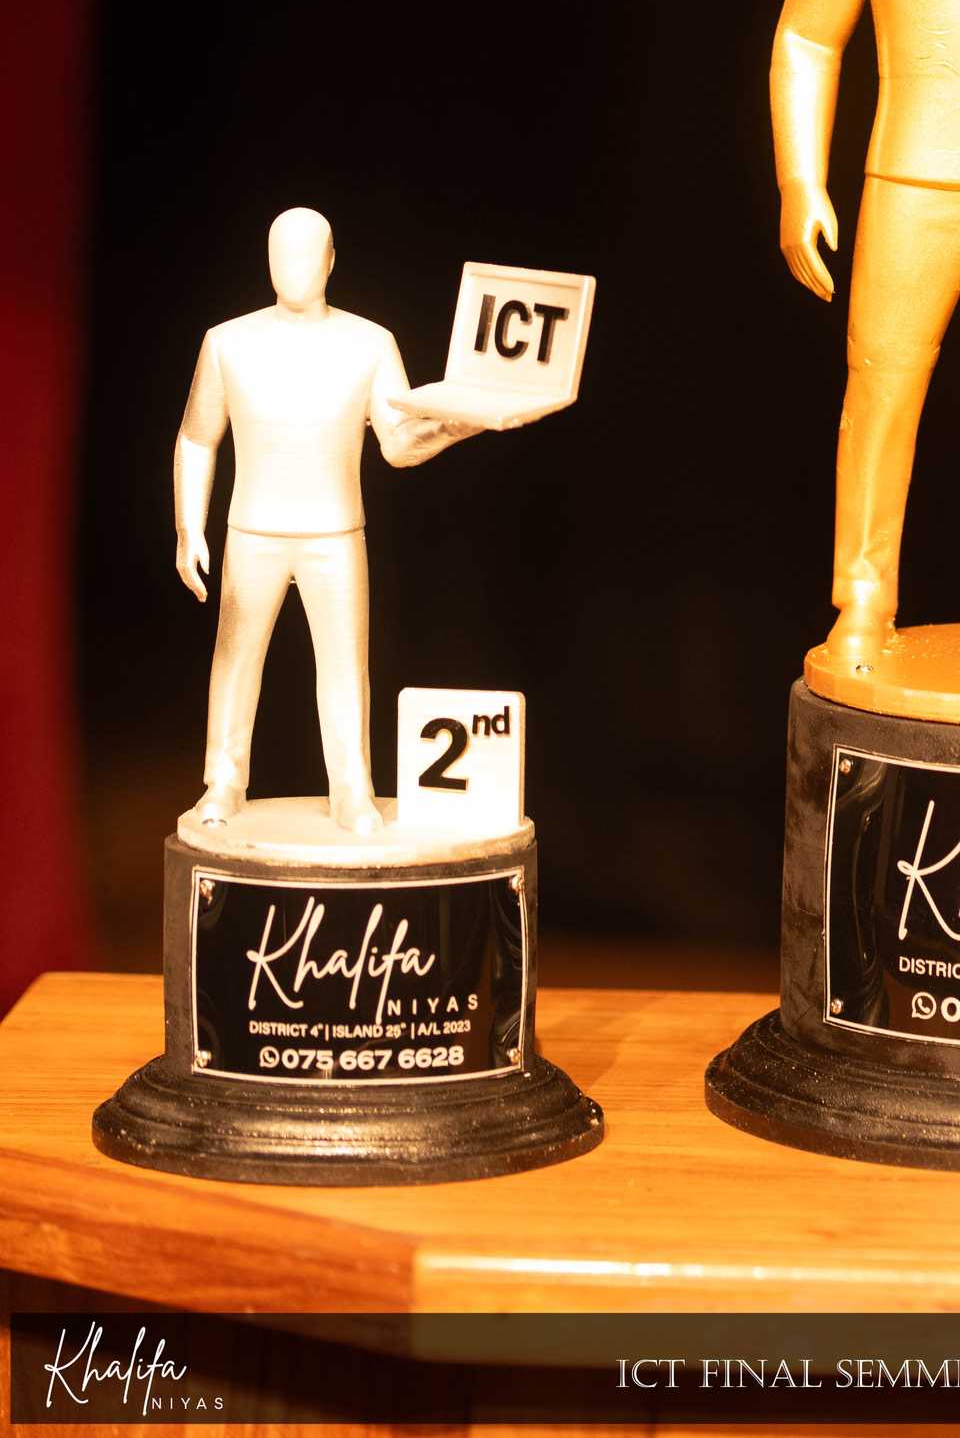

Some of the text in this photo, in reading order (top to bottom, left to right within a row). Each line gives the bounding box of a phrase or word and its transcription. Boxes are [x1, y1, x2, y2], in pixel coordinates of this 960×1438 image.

[474, 294, 570, 366] ICT
[418, 705, 512, 791] 2nd
[246, 896, 436, 1025] Khalifa
[249, 1020, 308, 1038] DISTRICT
[332, 1024, 384, 1039] ISLAND
[417, 1022, 441, 1037] A/L
[443, 1019, 471, 1035] 2023
[387, 993, 479, 1016] NIYAS
[281, 1045, 465, 1071] 075 667 6628
